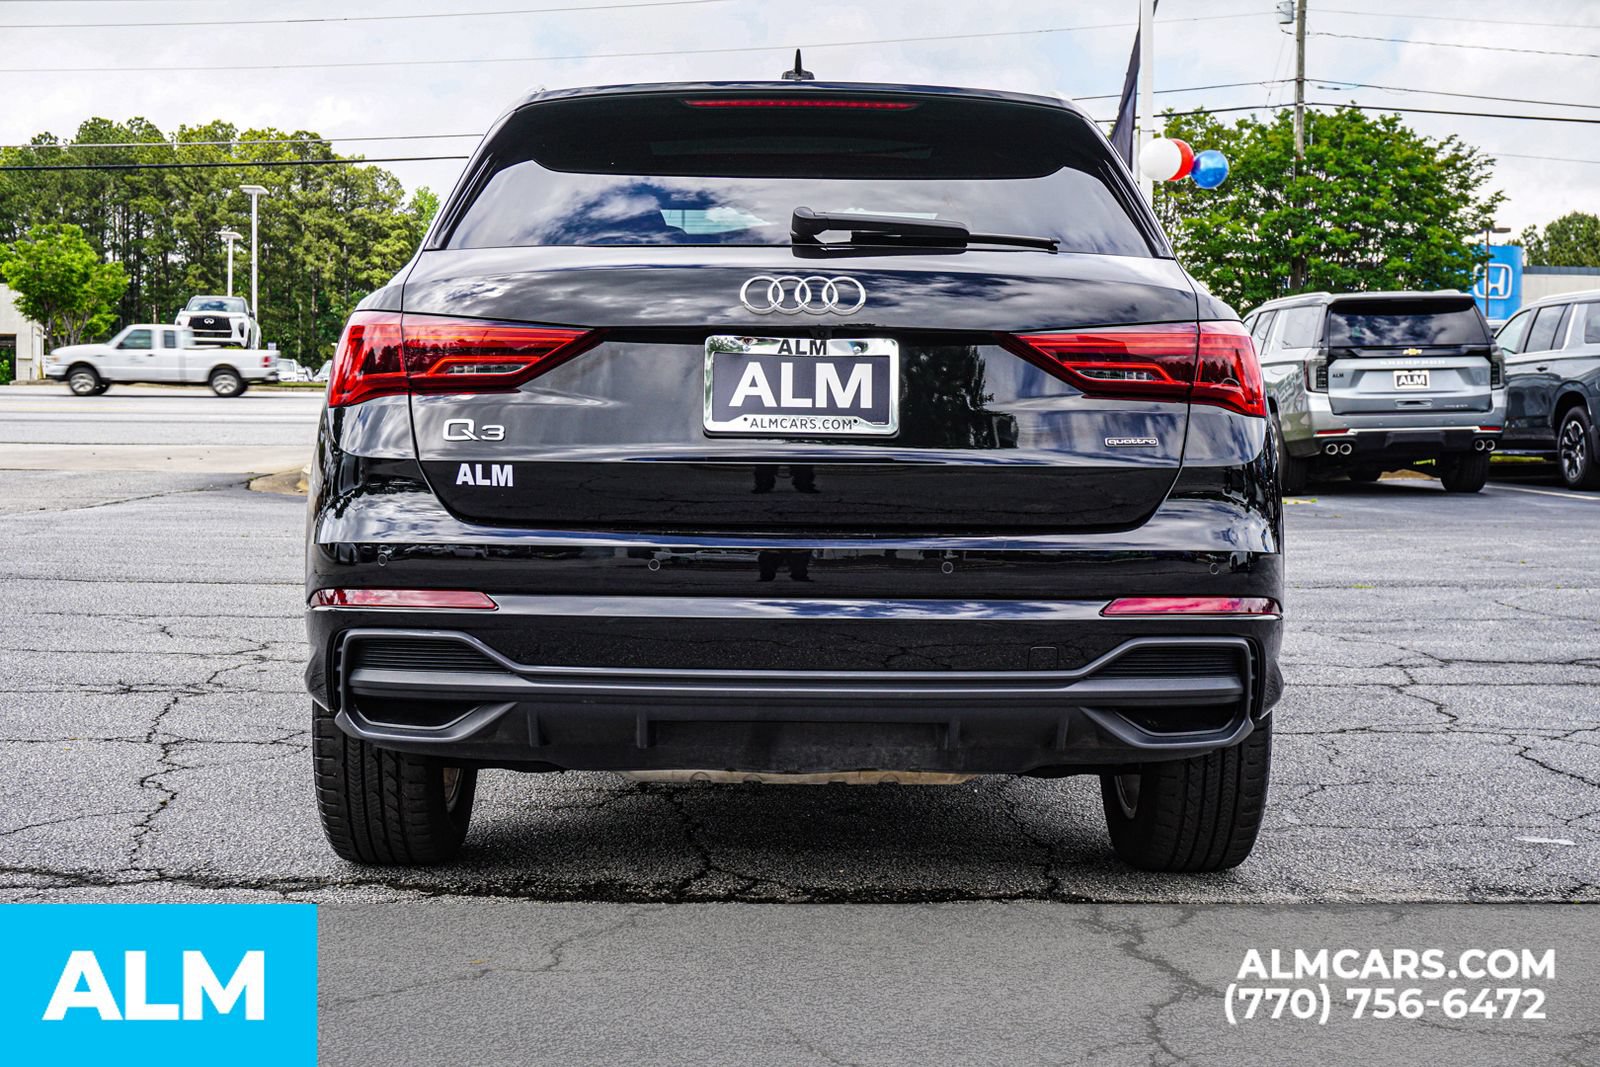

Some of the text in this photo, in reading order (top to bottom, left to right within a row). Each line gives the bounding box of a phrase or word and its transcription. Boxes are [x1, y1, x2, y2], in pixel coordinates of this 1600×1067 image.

[777, 339, 828, 356] ALM
[728, 361, 874, 409] ALM
[1398, 375, 1426, 385] ALM
[442, 418, 506, 441] Q3
[749, 417, 854, 430] ALMCARS.COM
[1108, 438, 1157, 446] quattro
[456, 463, 514, 487] ALM
